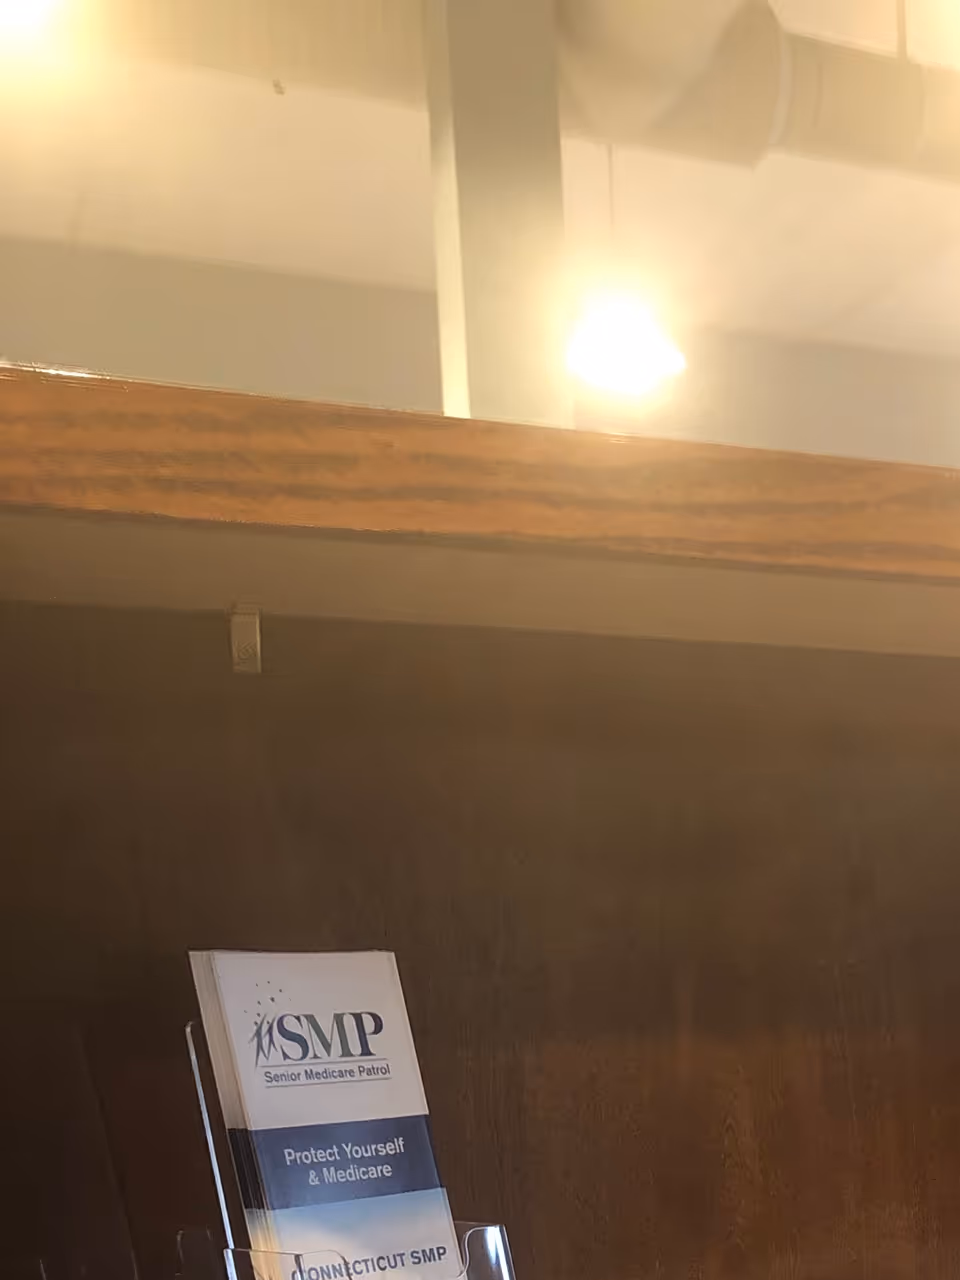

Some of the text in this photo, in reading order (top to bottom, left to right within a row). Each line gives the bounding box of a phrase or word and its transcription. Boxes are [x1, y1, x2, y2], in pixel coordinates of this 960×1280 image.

[276, 1011, 384, 1062] SMP
[264, 1063, 391, 1083] Senior Medicare Patrol
[284, 1137, 404, 1165] Protect Yourself
[308, 1164, 392, 1186] & Medicare
[411, 1246, 447, 1265] SMP
